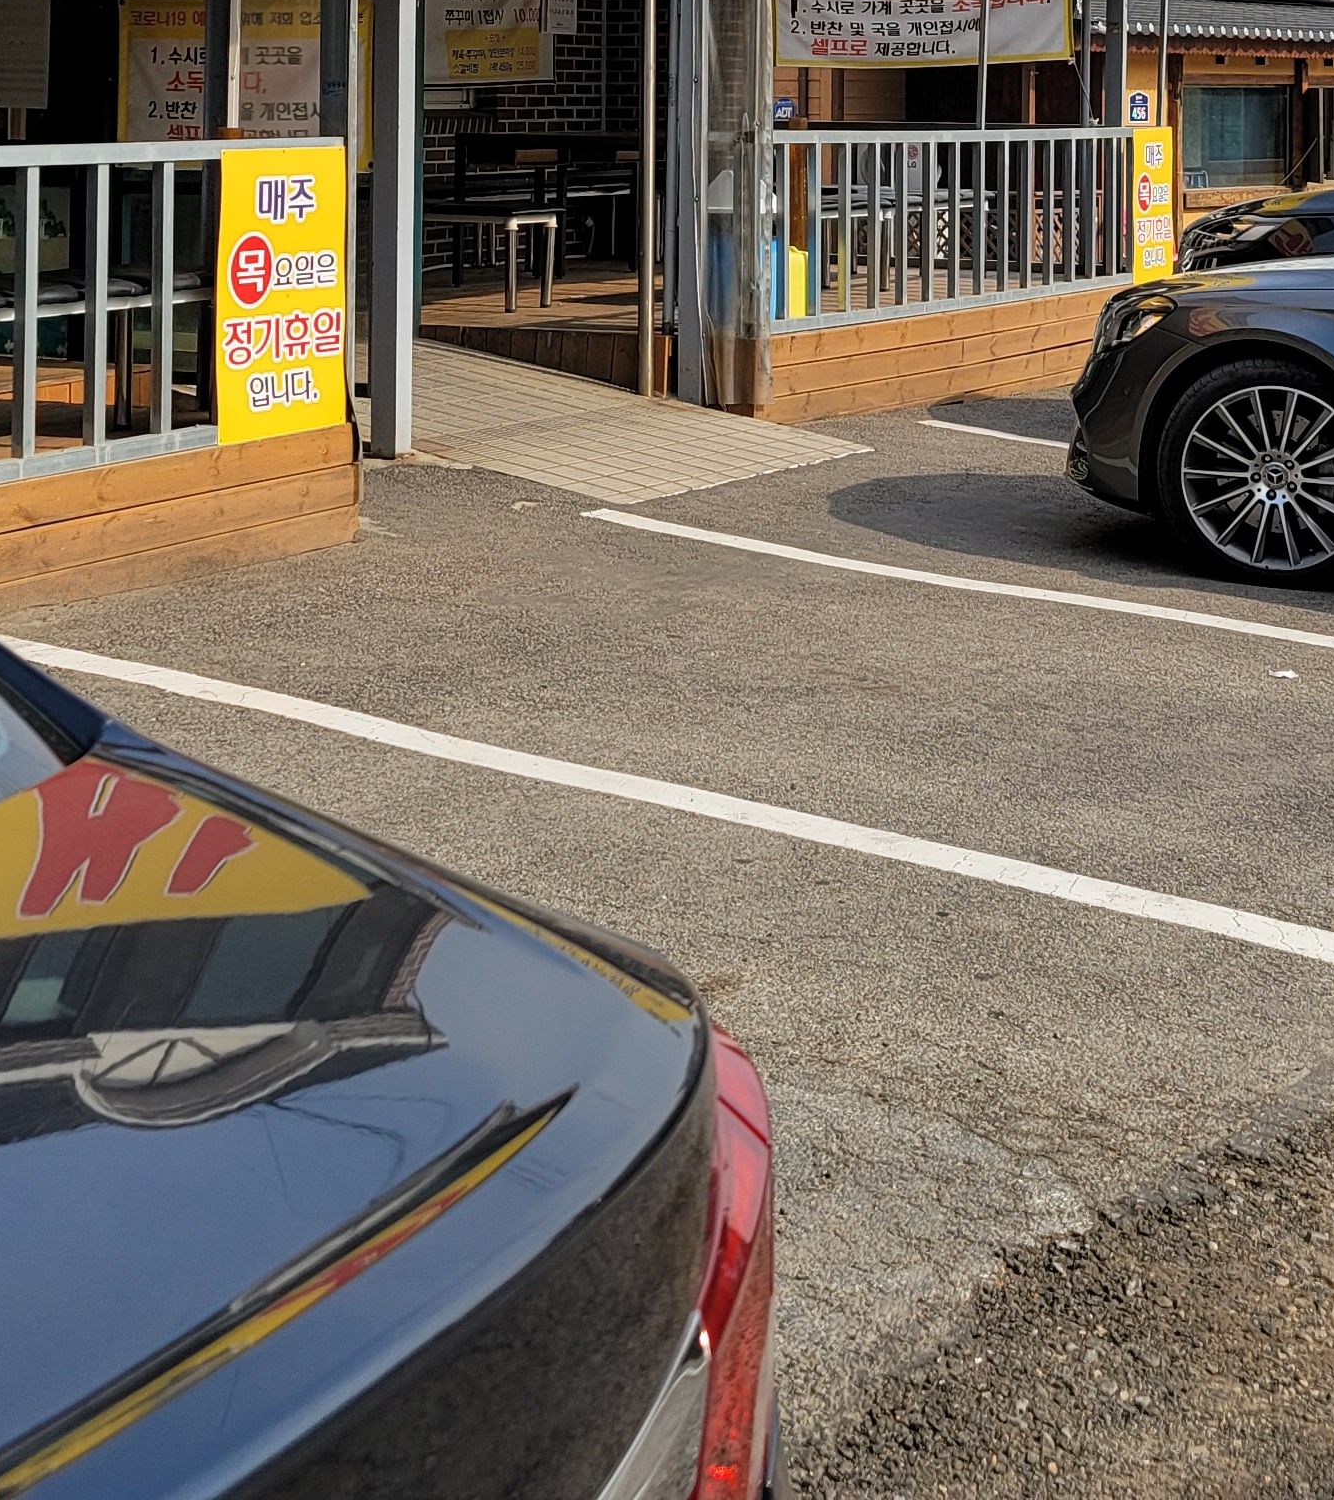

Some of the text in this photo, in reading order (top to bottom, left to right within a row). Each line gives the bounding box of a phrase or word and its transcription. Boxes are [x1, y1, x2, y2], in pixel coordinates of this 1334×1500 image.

[130, 10, 187, 27] 코로나19
[860, 0, 893, 16] 가계
[810, 20, 844, 37] 반찬
[849, 21, 866, 38] 및
[870, 21, 901, 38] 국을
[810, 37, 956, 58] 셀프로 제공합니다.
[775, 106, 793, 119] ADT
[1131, 106, 1146, 120] 456
[1145, 144, 1164, 168] 매주
[257, 176, 316, 222] 매주
[1136, 216, 1172, 244] 정기휴일
[1144, 247, 1166, 267] 입니다.
[235, 249, 337, 293] 목요일은
[224, 310, 342, 367] 정기휴일
[249, 370, 319, 408] 입니다.
